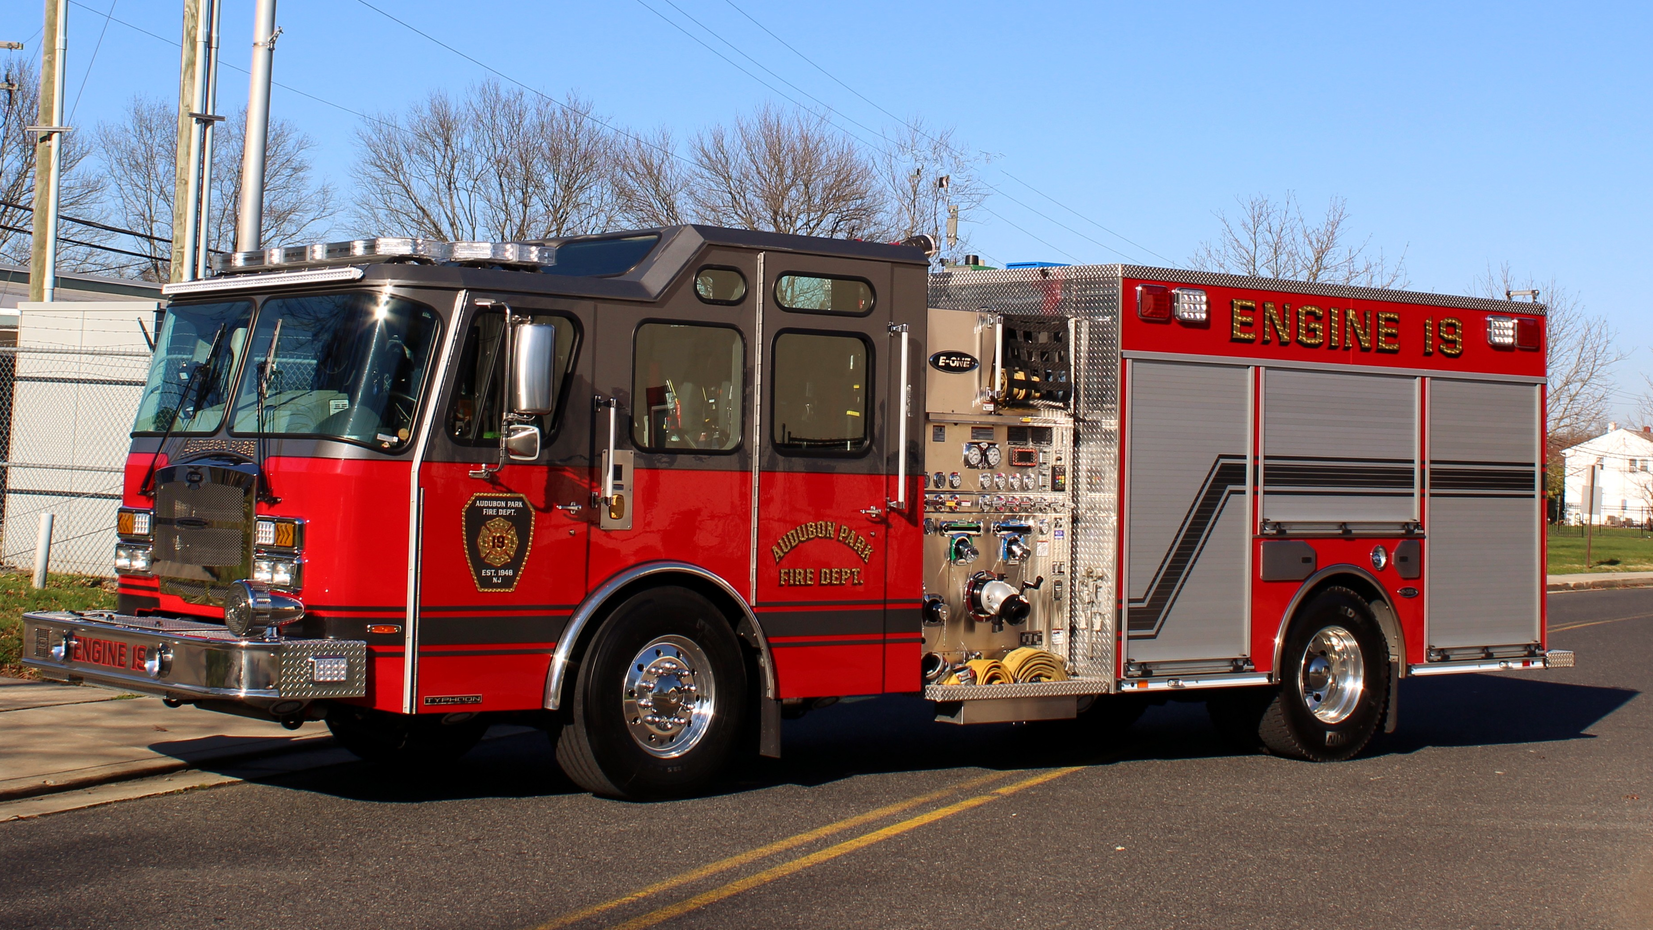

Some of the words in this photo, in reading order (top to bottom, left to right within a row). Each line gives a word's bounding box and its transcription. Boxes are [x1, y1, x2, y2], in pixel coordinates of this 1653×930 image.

[1231, 298, 1400, 353] ENGINE
[1423, 316, 1463, 356] 19
[938, 355, 971, 368] E-ONE
[181, 439, 227, 458] AUDUBON
[229, 440, 257, 458] PARK
[475, 500, 506, 508] AUDUBON
[491, 535, 505, 549] 19
[771, 520, 836, 565] AUDUBON
[837, 524, 874, 564] PARK
[779, 568, 814, 586] FIRE
[819, 568, 864, 586] DEPT.
[72, 636, 127, 669] ENGINE
[131, 644, 147, 672] 19
